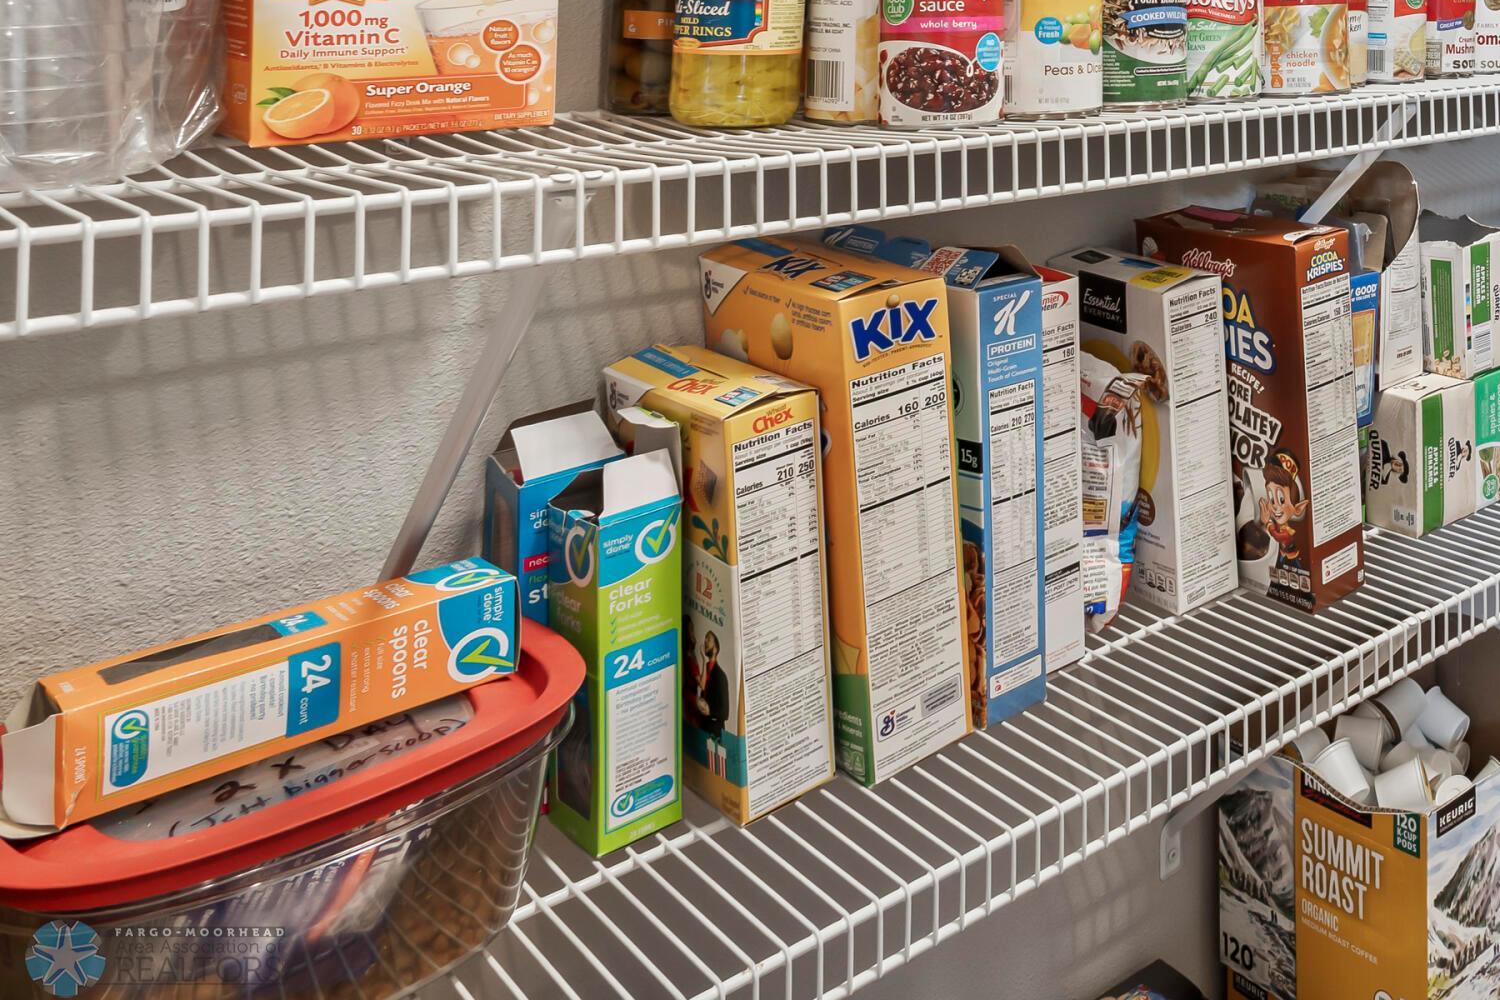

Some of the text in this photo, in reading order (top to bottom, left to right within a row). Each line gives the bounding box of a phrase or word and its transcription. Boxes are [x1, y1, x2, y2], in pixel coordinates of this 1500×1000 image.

[298, 10, 388, 30] 1,000 mg
[921, 20, 977, 31] whole berry
[1131, 11, 1165, 22] COOKED
[285, 28, 400, 47] Vitamin C
[692, 25, 732, 38] RINGS
[280, 46, 405, 59] Daily Immune Support
[1286, 51, 1318, 59] chicken
[1286, 59, 1316, 67] noodle
[366, 80, 471, 98] Super Orange
[1182, 250, 1235, 277] Kellogg's
[1306, 259, 1343, 281] KRISPIES
[1311, 252, 1338, 267] COCOA
[1083, 288, 1121, 314] Essential
[851, 298, 939, 360] KIX
[990, 338, 1033, 356] PROTEIN
[851, 353, 943, 389] Nutrition Facts
[1232, 363, 1264, 395] RECIPE!
[752, 409, 794, 434] Chex
[734, 420, 813, 452] Nutrition Facts
[960, 450, 978, 468] 15g
[1368, 429, 1382, 490] QUAKER
[603, 534, 634, 550] simply
[609, 577, 652, 601] clear
[609, 590, 652, 615] forks
[414, 619, 432, 670] clear
[300, 652, 333, 694] 24
[388, 625, 408, 698] spoons
[613, 650, 645, 679] 24
[1437, 798, 1475, 827] KEURIG
[1301, 817, 1384, 889] SUMMIT
[1302, 855, 1367, 920] ROAST
[1302, 898, 1339, 932] ORGANIC
